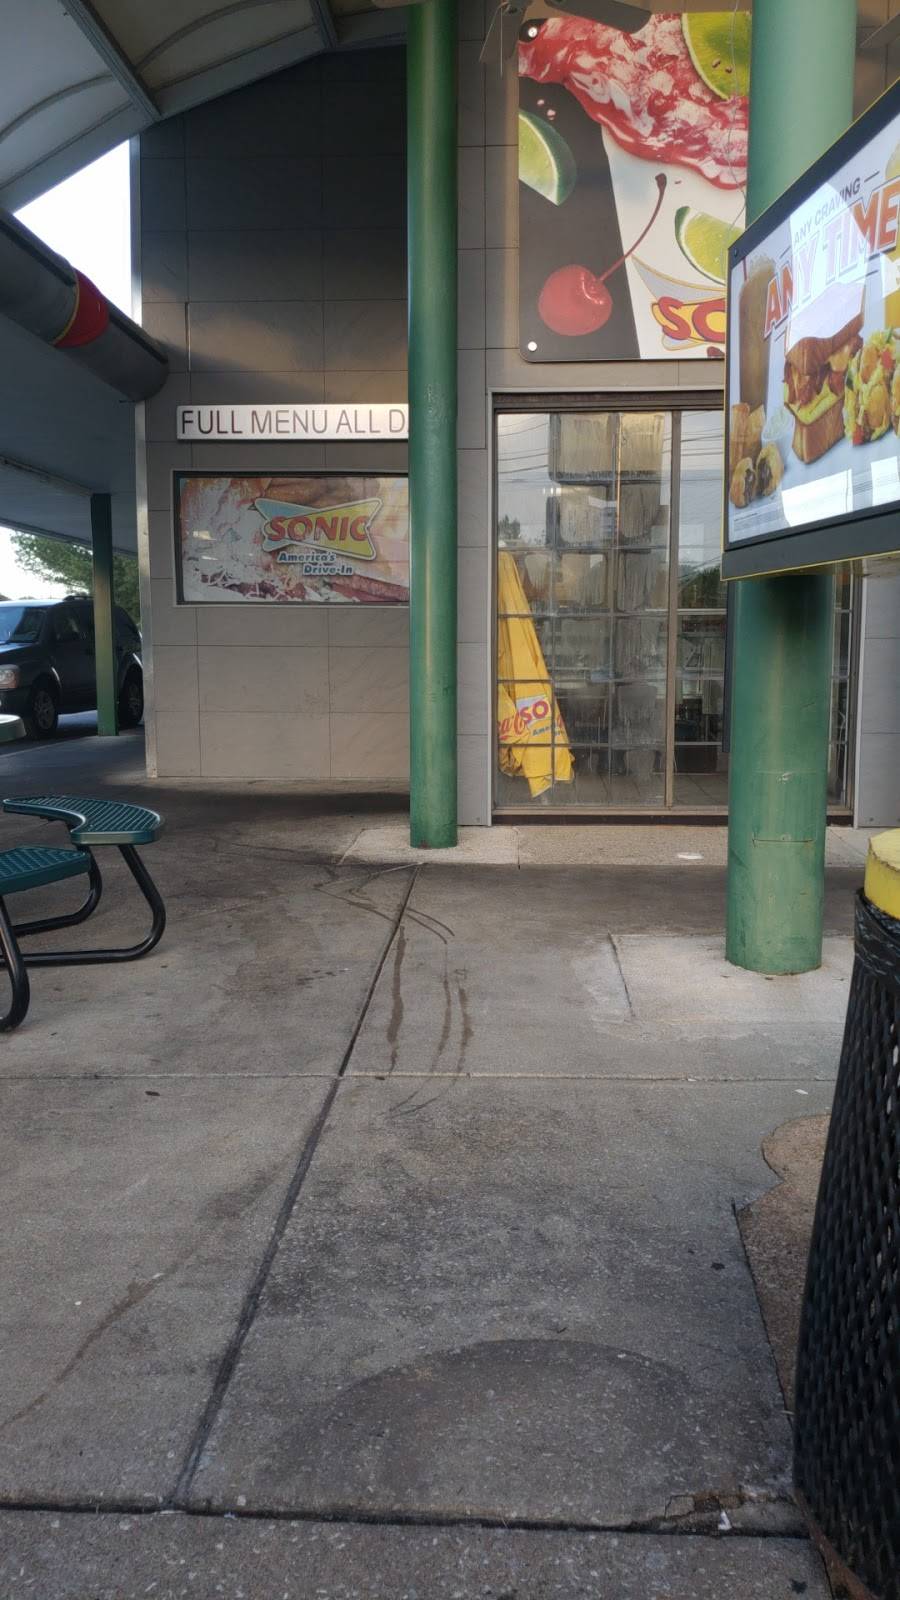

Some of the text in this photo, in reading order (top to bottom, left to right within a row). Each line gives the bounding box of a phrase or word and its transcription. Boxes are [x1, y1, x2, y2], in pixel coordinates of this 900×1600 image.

[794, 177, 861, 245] ANY CRAVING
[764, 229, 820, 340] ANY
[181, 409, 409, 434] FULL MENU ALL D
[268, 515, 370, 542] SONIC
[279, 551, 337, 562] America's
[303, 564, 353, 575] Drive-In
